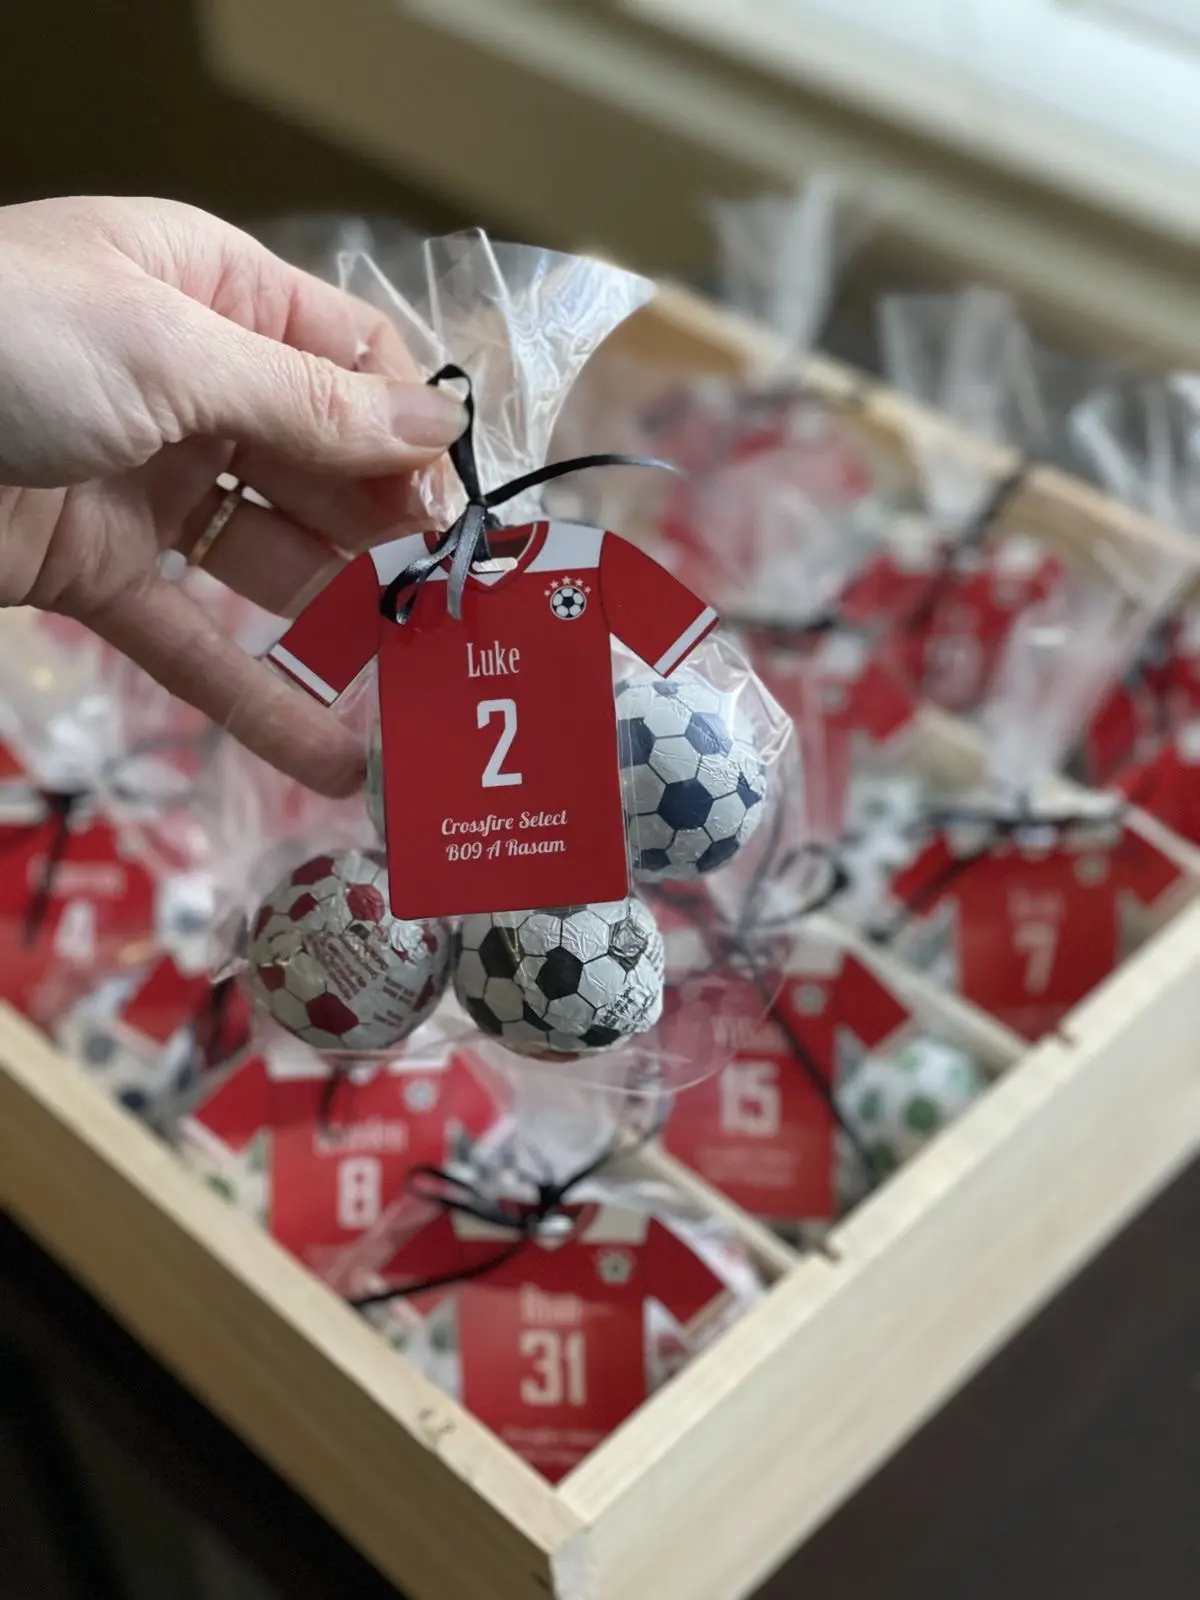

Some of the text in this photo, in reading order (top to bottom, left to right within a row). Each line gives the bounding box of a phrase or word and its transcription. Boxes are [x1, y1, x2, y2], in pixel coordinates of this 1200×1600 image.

[466, 641, 521, 678] Luke
[476, 698, 523, 788] 2
[441, 810, 568, 837] Crossfire Select
[446, 838, 566, 861] B09 A Rasam
[1012, 921, 1060, 996] 7
[337, 1156, 384, 1229] 8
[519, 1328, 587, 1408] 31
